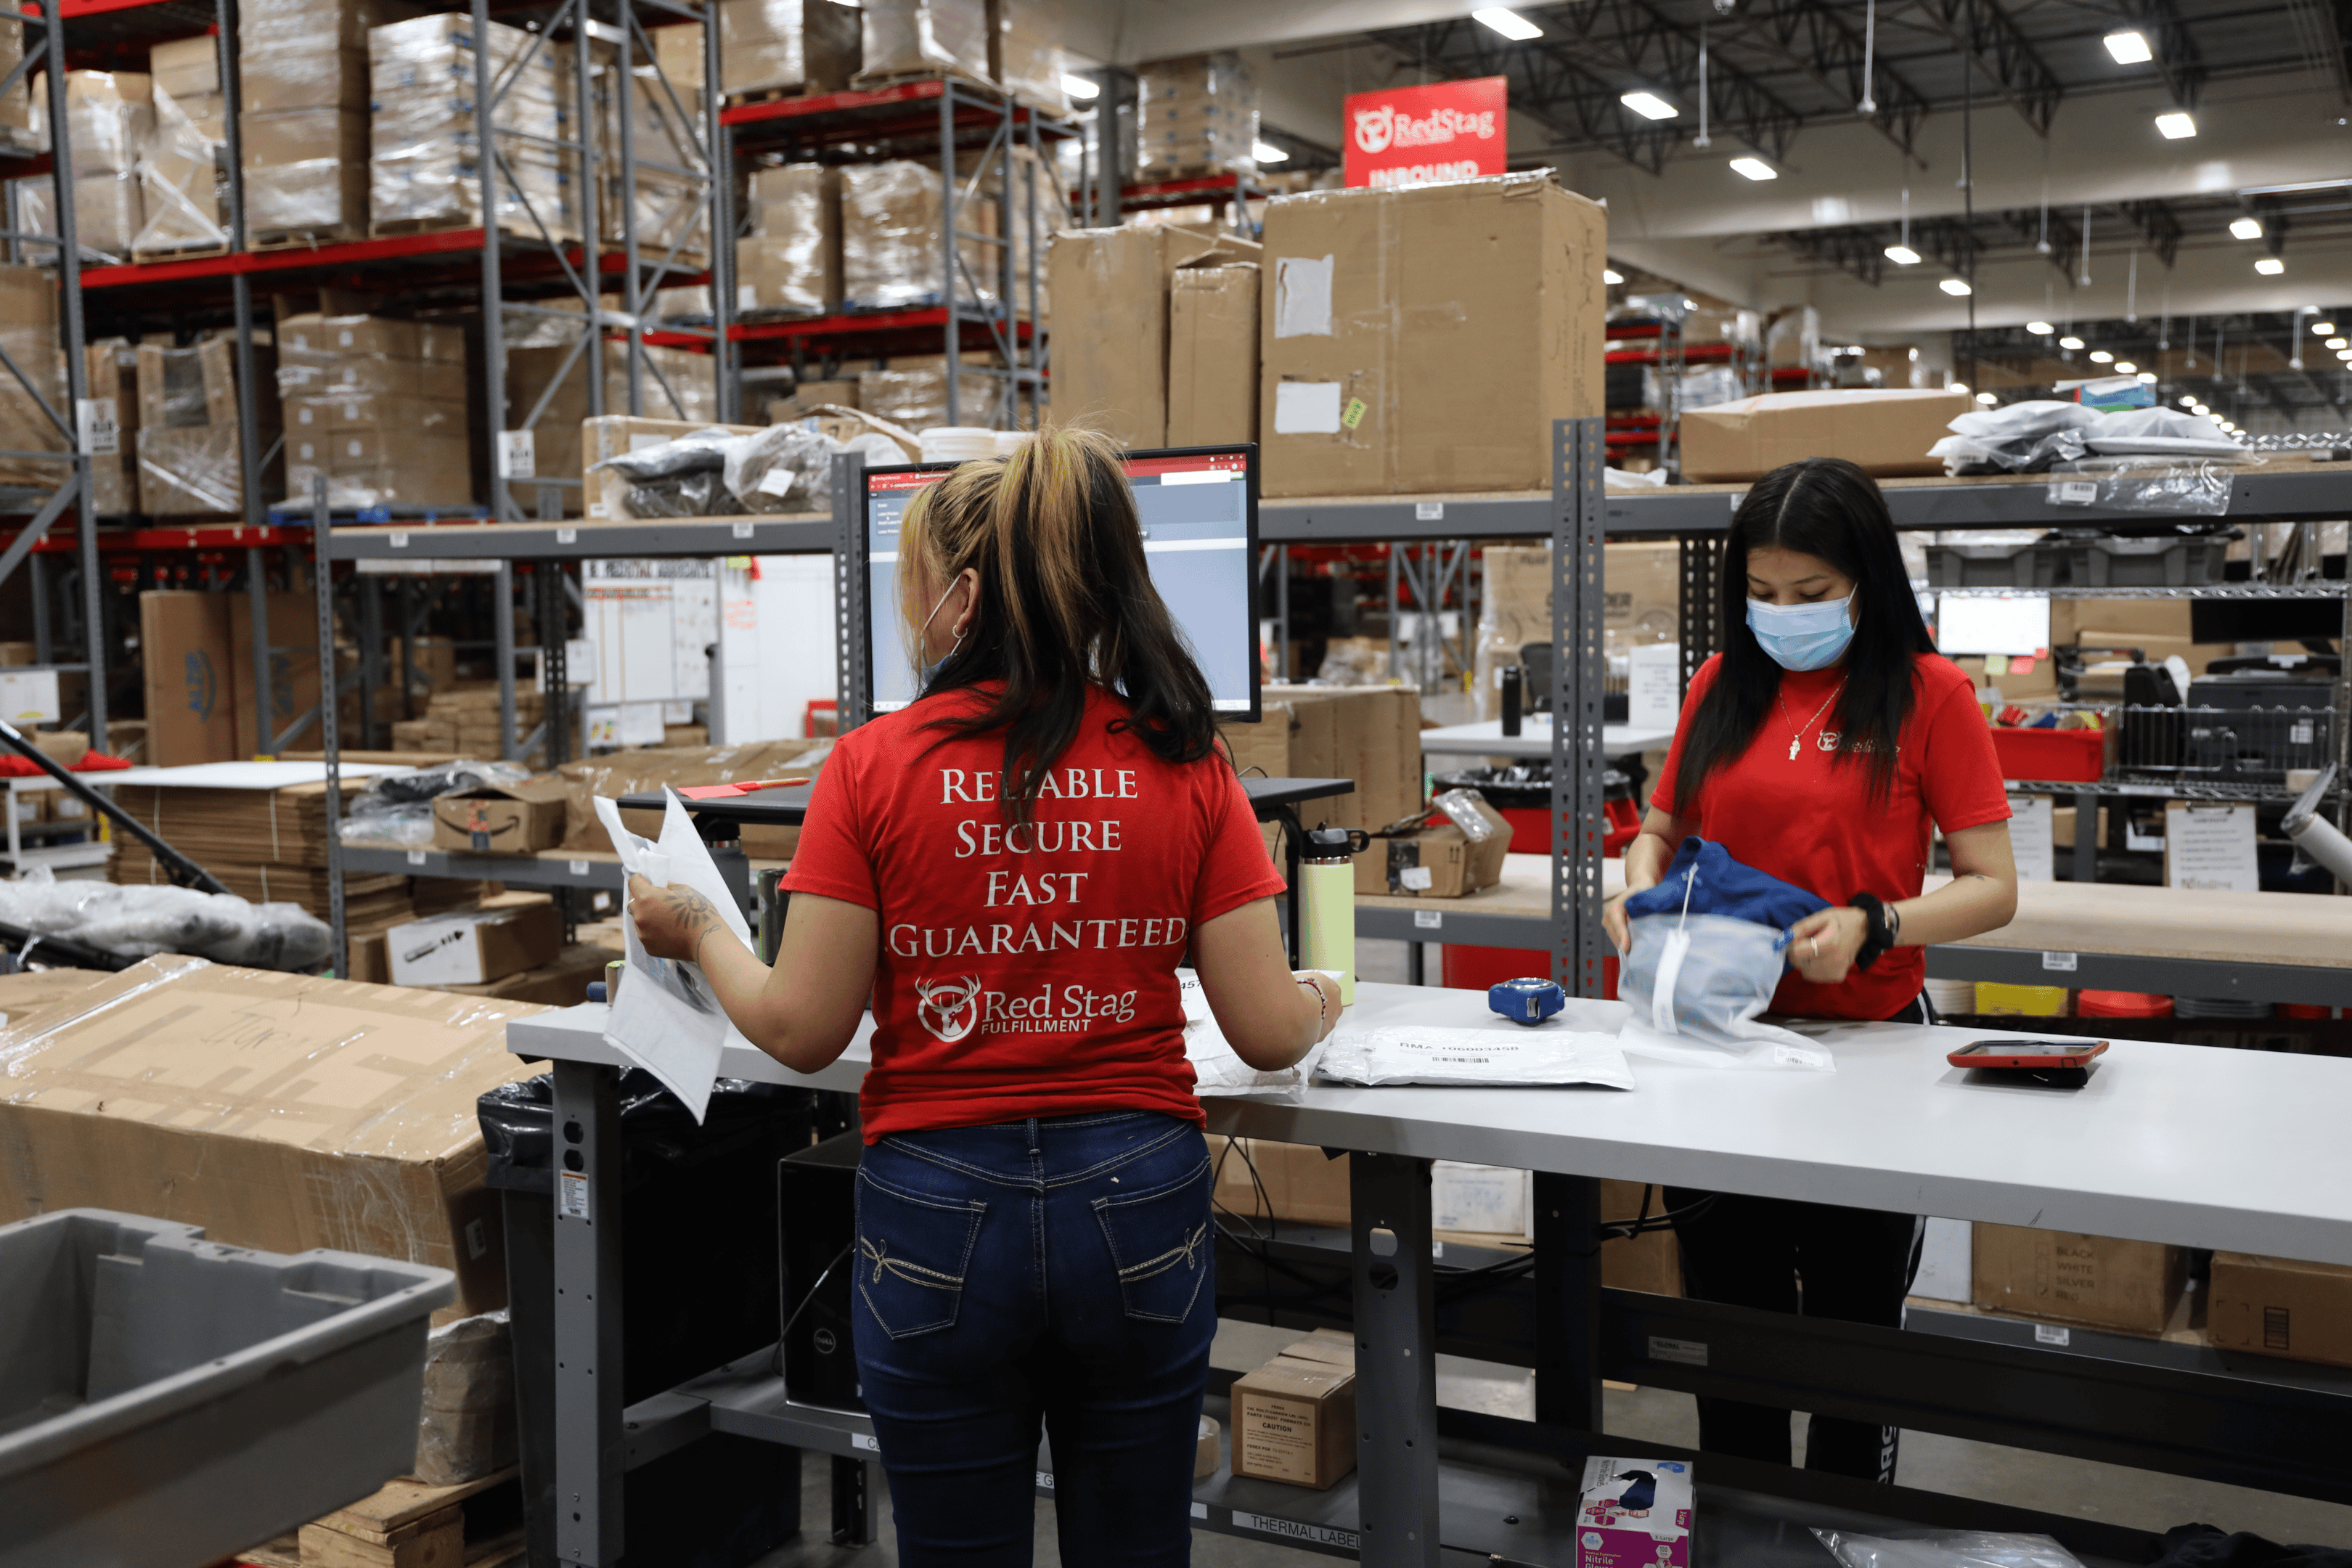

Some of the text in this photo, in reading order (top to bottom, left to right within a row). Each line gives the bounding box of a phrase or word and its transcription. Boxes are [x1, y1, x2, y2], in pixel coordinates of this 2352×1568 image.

[939, 768, 1138, 804] REABLE
[955, 819, 1122, 858] SECURE
[984, 870, 1089, 907] FAST
[890, 918, 1186, 957] GUARANTEED
[983, 984, 1138, 1023] Red Stag
[981, 1019, 1091, 1034] FULFILLMENT
[2057, 1246, 2094, 1259] BLACK
[2057, 1262, 2093, 1275] WHITE
[2057, 1277, 2094, 1289] SILVER
[1262, 1422, 1292, 1433] CAUTION
[1251, 1514, 1317, 1540] THERMAL
[1585, 1555, 1614, 1565] Nitrile
